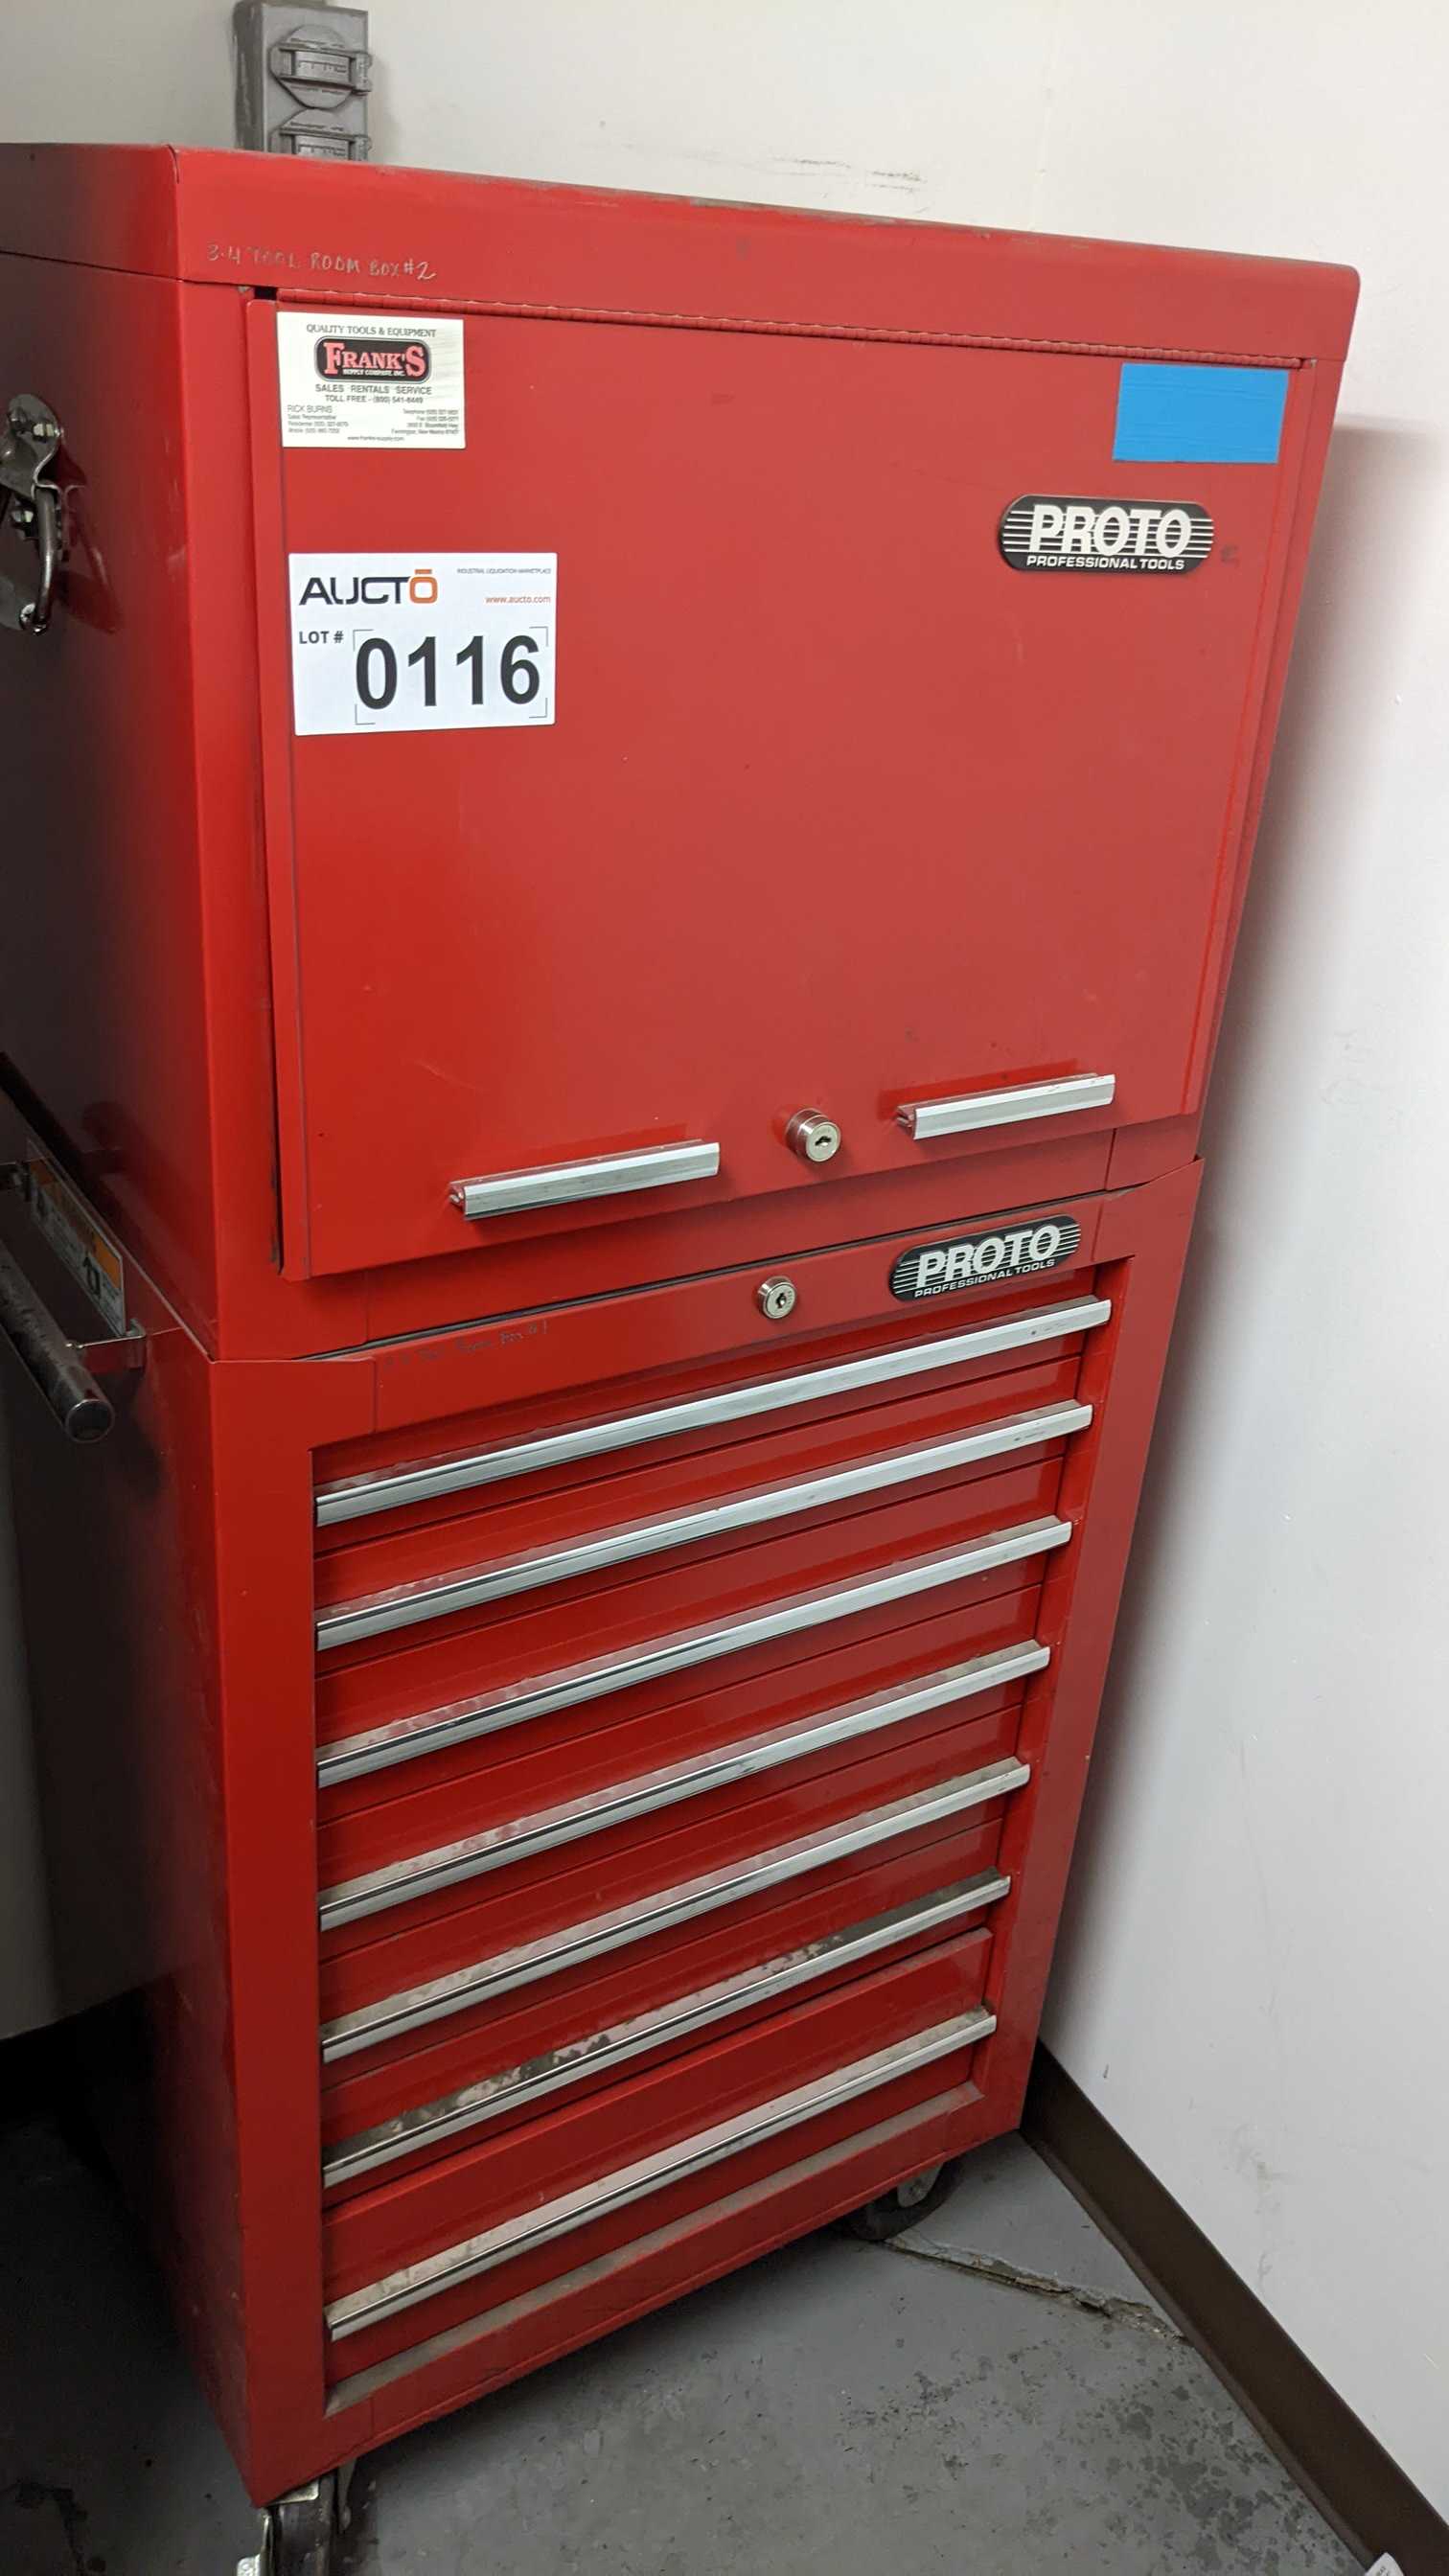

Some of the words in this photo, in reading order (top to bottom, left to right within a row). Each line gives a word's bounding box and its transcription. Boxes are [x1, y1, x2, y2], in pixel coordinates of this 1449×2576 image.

[310, 252, 360, 273] ROOM
[307, 324, 344, 334] QUALITY
[348, 326, 377, 335] TOOLS
[379, 327, 385, 335] &
[387, 327, 437, 337] EQUIPMENT
[315, 384, 344, 393] SALES
[351, 385, 389, 394] RENTALS
[395, 385, 432, 395] SERVICE
[325, 394, 345, 402] TOLL
[1029, 504, 1192, 559] PROTO
[1026, 556, 1138, 569] PROFESSIONAL
[1138, 559, 1185, 571] TOOLS
[485, 596, 552, 605] www.aucto.com
[299, 631, 329, 645] LOT
[356, 634, 540, 710] 0116
[915, 1224, 1061, 1288] PROTO
[913, 1269, 1013, 1298] PROFESSIONAL
[1013, 1258, 1055, 1276] TOOLS
